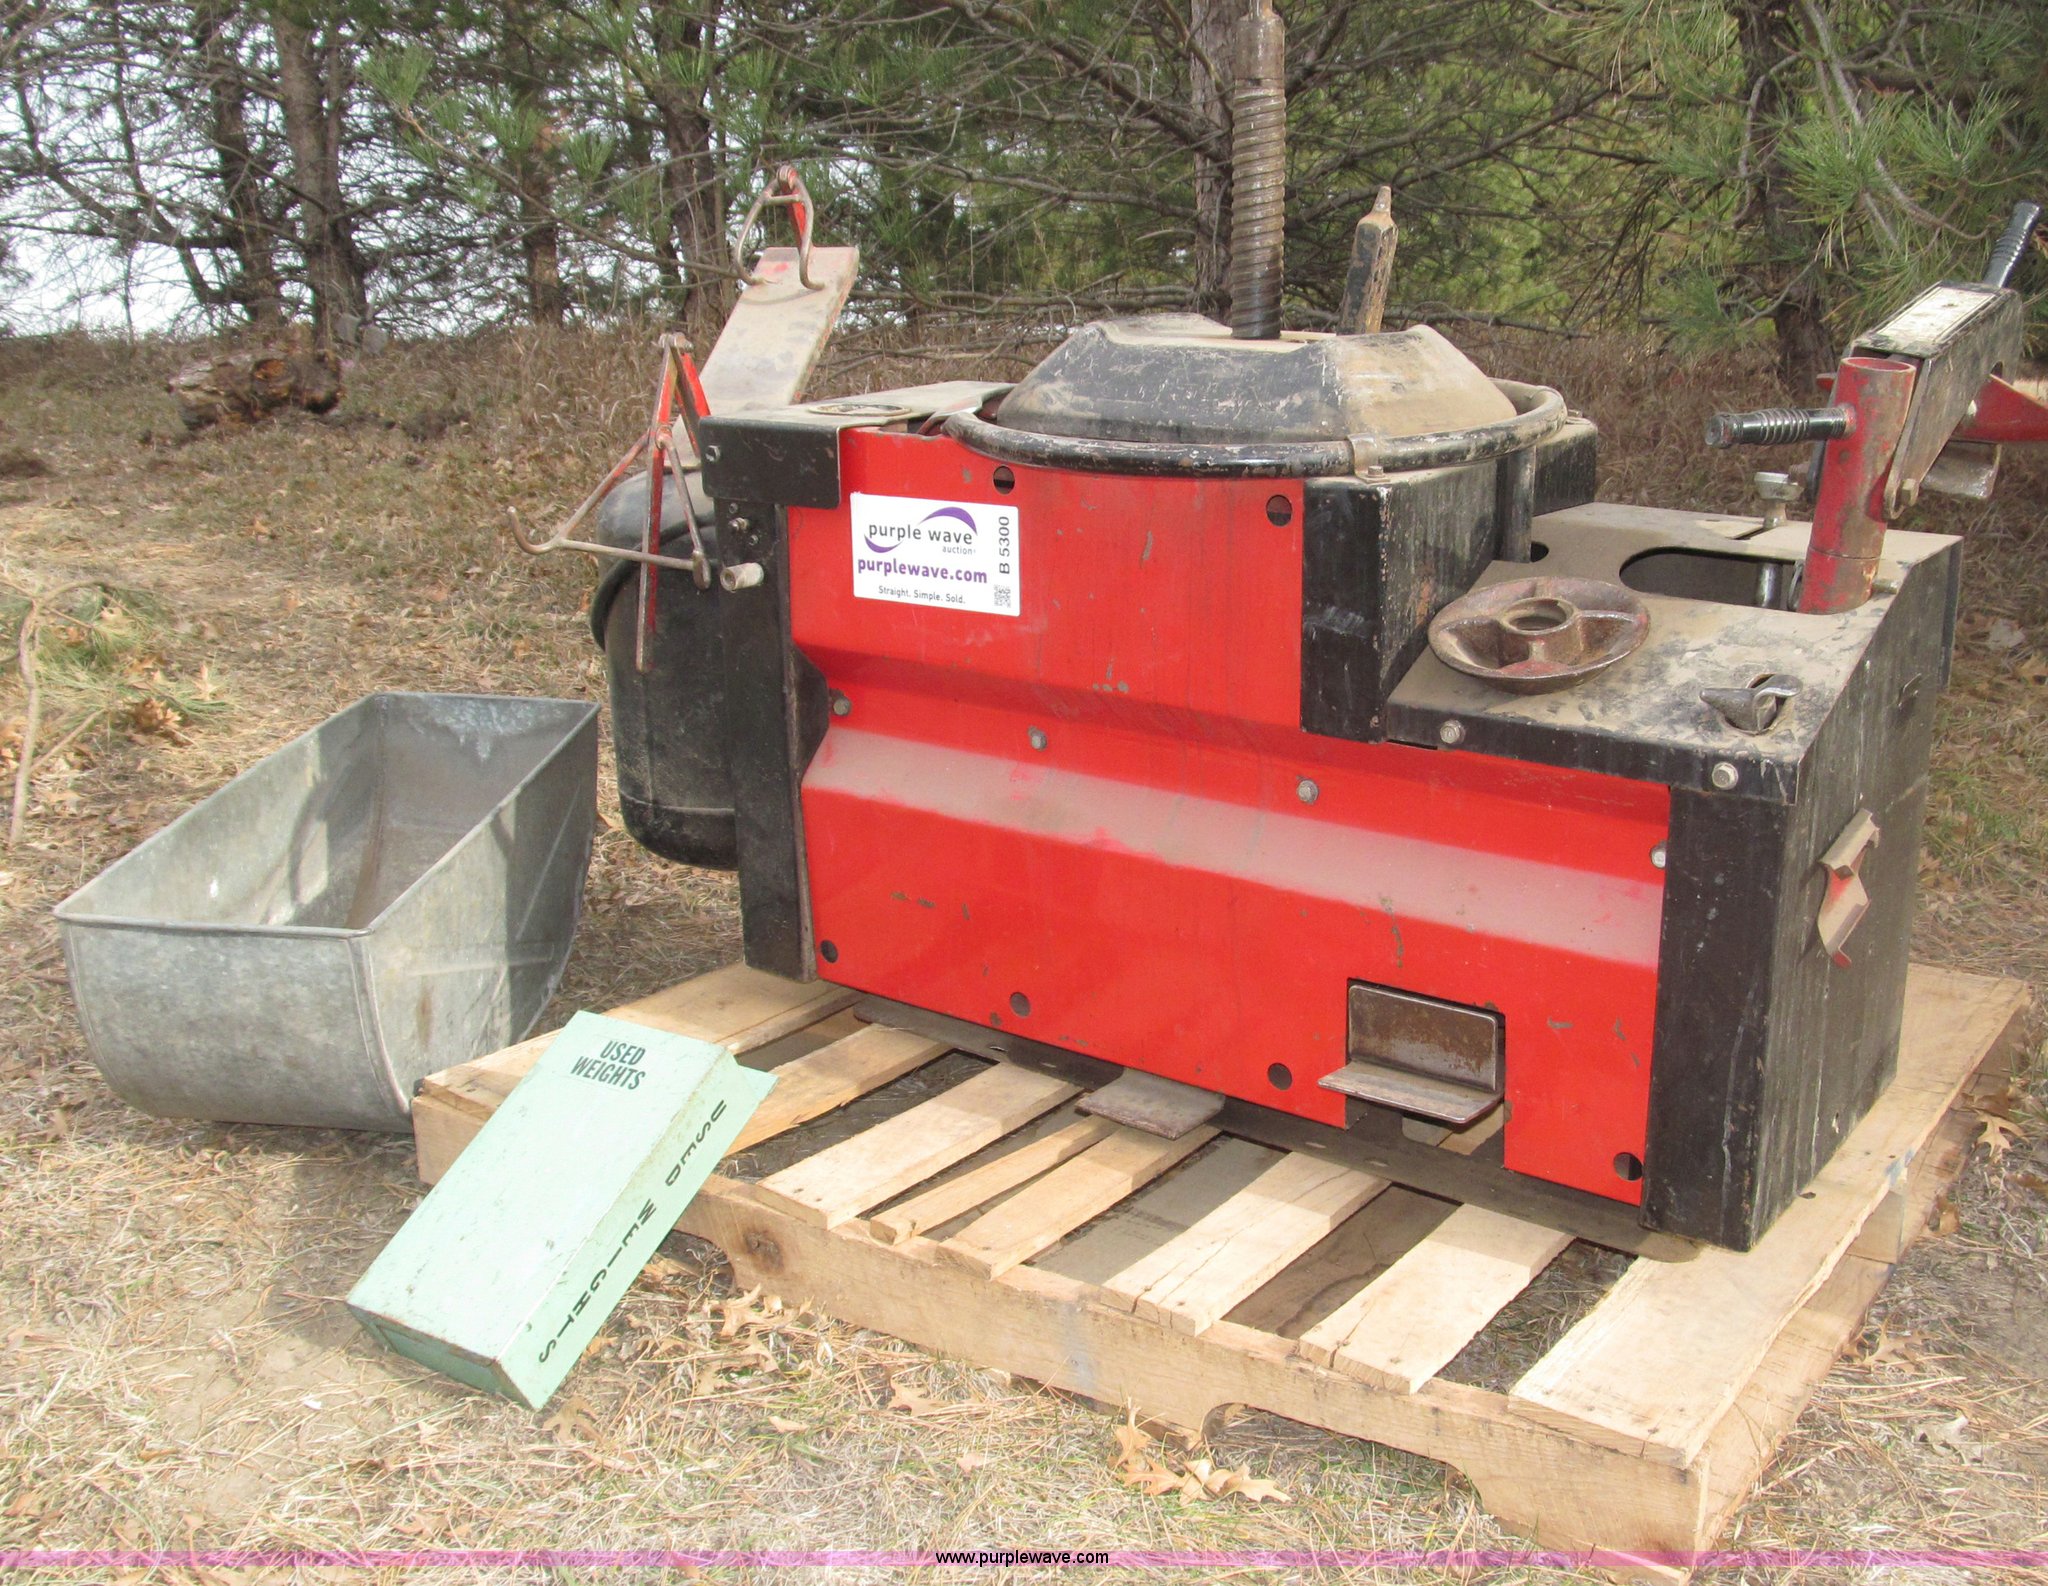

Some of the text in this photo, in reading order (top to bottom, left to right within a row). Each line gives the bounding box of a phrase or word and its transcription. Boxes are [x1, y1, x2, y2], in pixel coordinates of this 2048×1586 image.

[869, 524, 973, 545] purple wave
[998, 516, 1010, 574] B 5300
[942, 546, 973, 555] auction
[858, 558, 988, 583] purplewave.com
[878, 585, 966, 604] Straight. Simple. Sold.
[599, 1040, 646, 1066] USED
[570, 1055, 646, 1090] WEIGHTS
[538, 1099, 727, 1363] USED WEIGHTS
